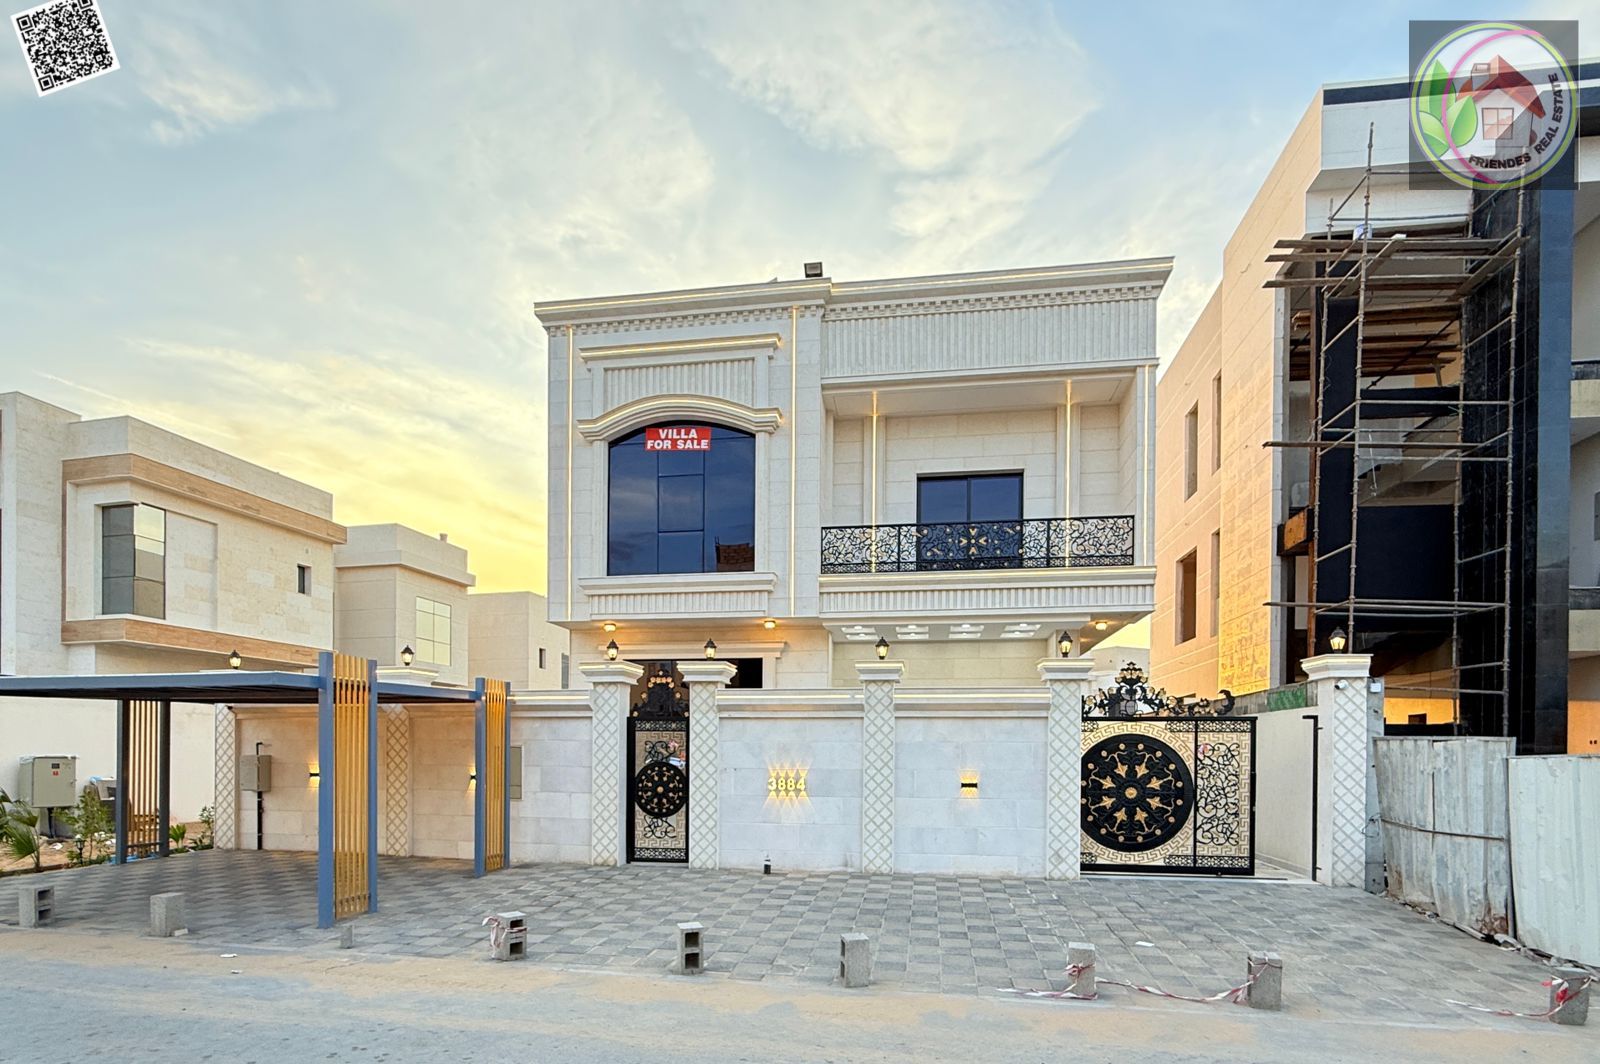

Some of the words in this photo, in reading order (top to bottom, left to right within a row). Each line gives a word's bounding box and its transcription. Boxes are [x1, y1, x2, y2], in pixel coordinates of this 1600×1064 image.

[658, 428, 698, 439] VILLA
[646, 439, 672, 450] FOR
[676, 439, 709, 449] SALE
[767, 776, 806, 791] 3884
